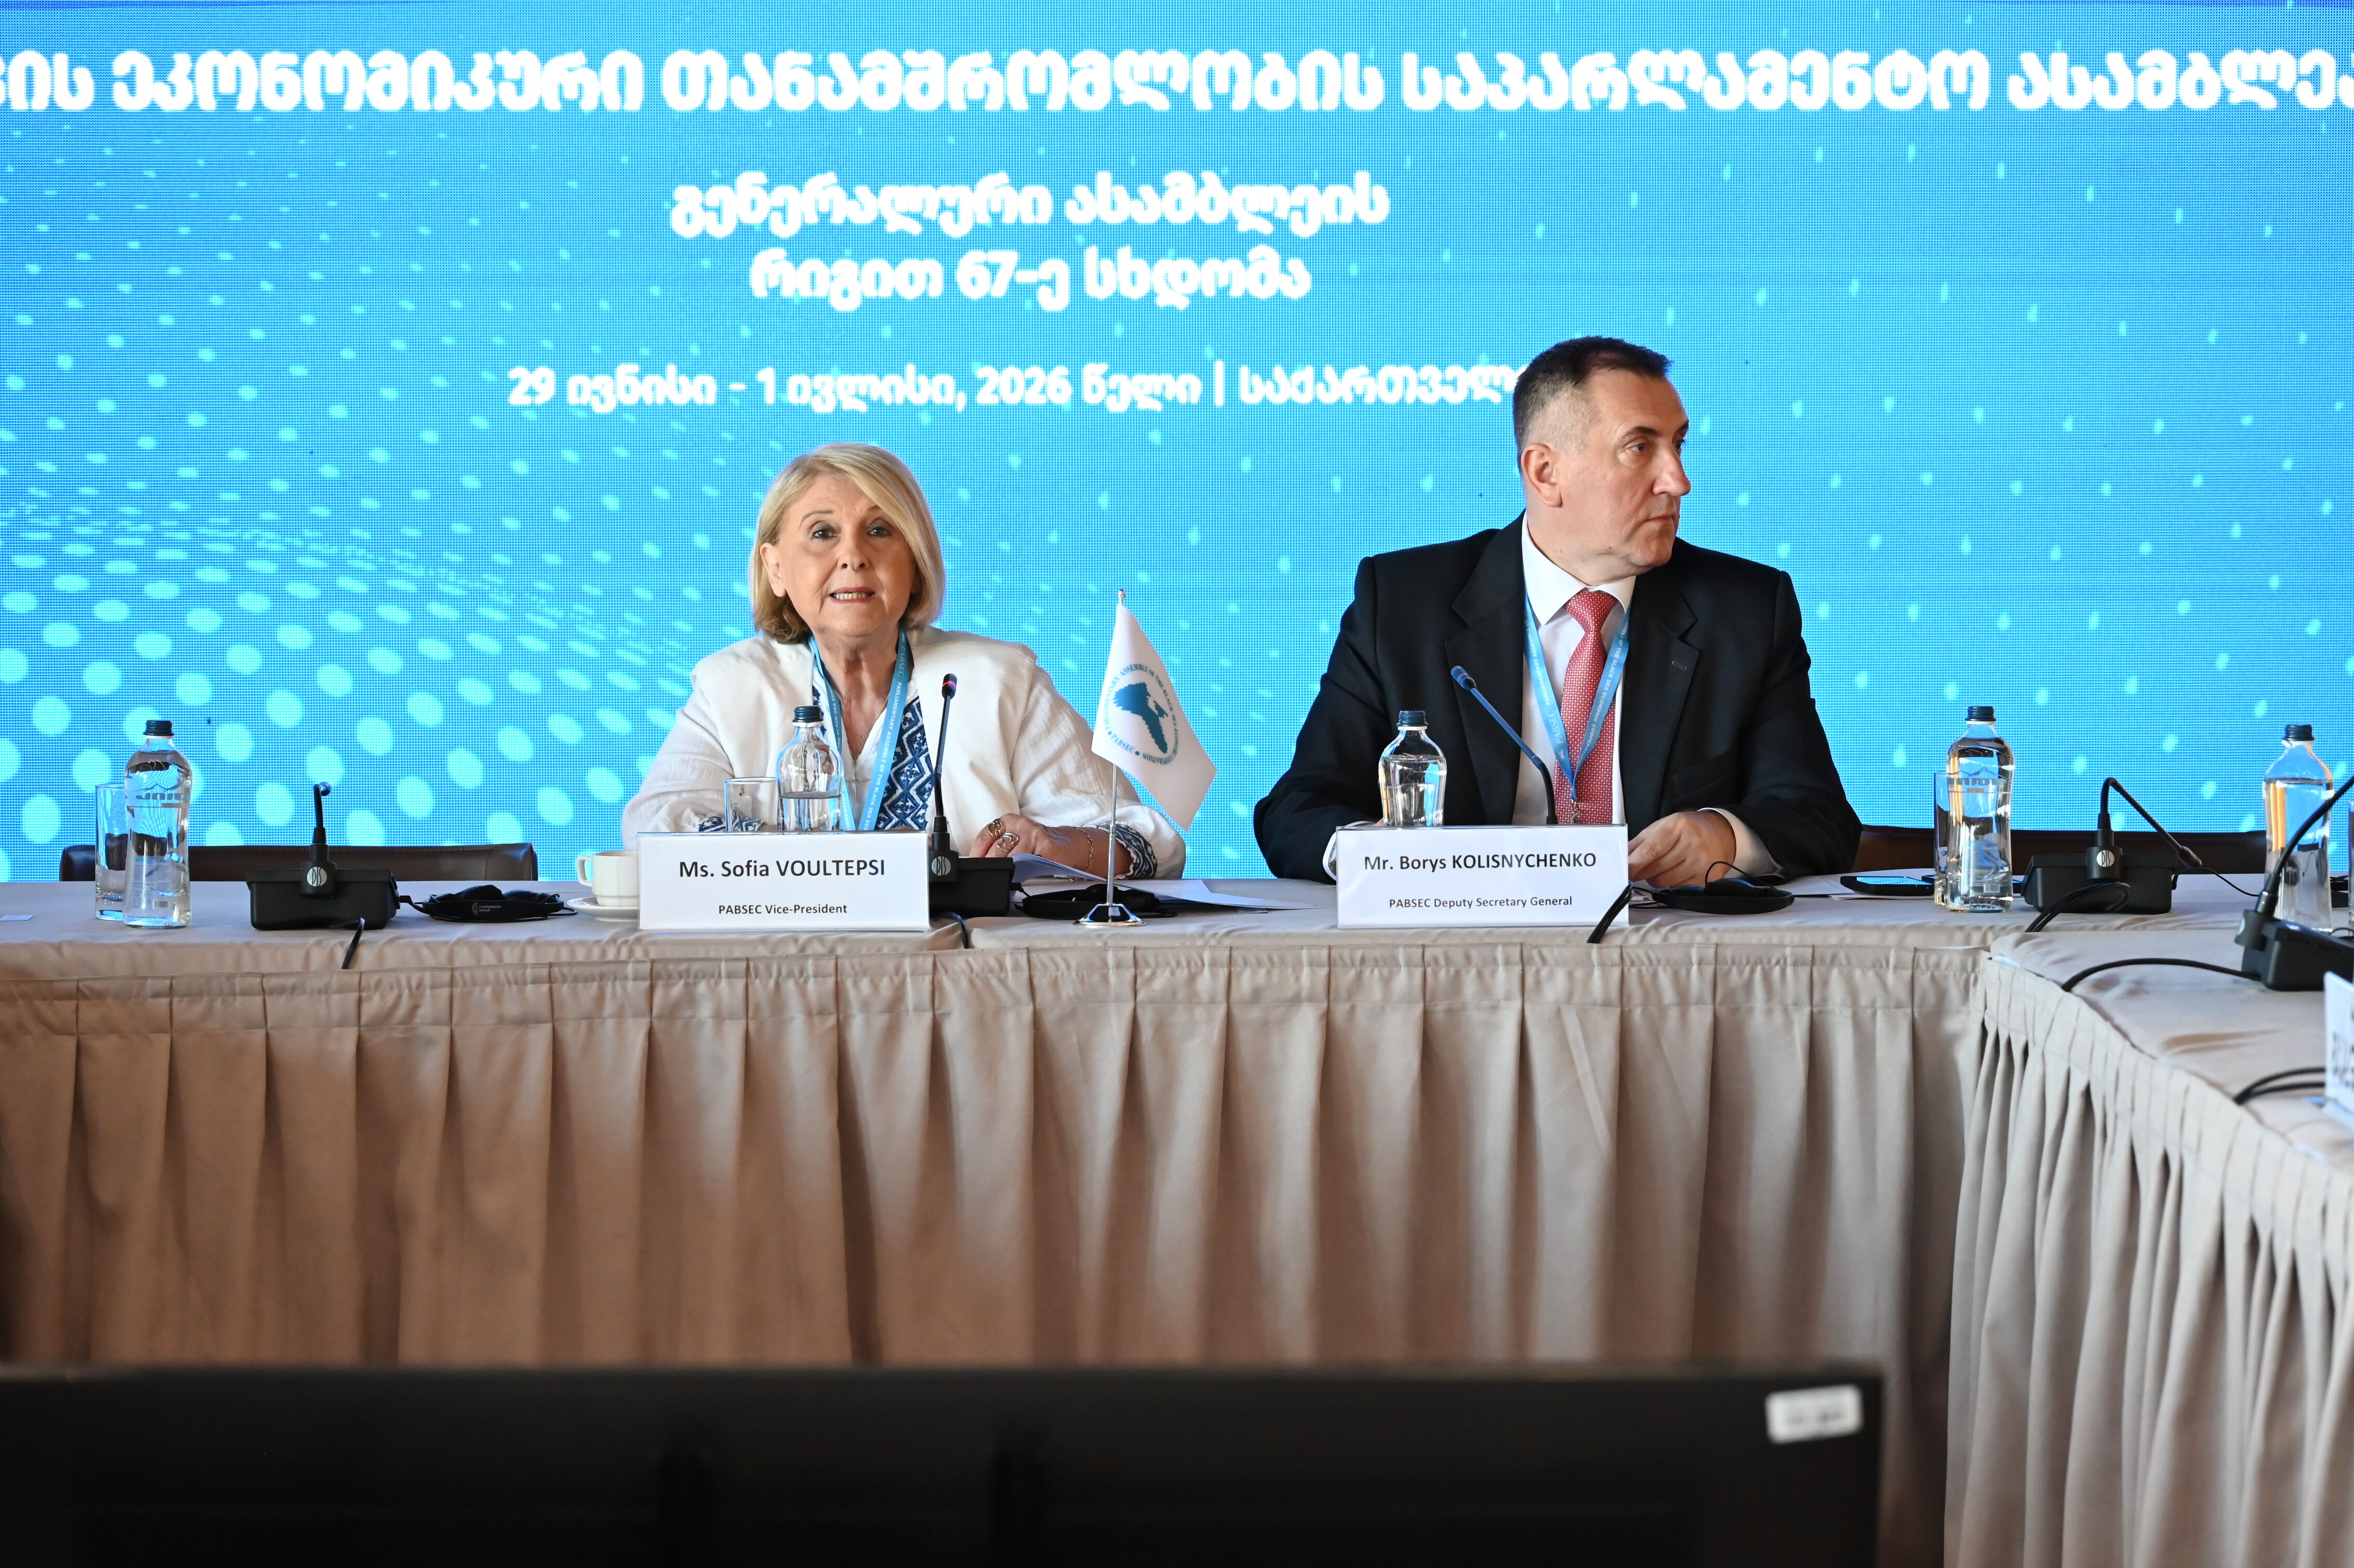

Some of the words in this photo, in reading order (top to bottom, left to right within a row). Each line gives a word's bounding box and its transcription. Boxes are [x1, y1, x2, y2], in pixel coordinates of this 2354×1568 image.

[0, 50, 94, 110] ის
[114, 50, 643, 110] ეკონომიკური
[663, 50, 1383, 110] თანამშრომლობის
[1403, 50, 1989, 110] საპარლამენტო
[672, 172, 1052, 238] გენერალური
[1066, 172, 1389, 237] ასამბლეის
[751, 249, 943, 311] რიგით
[957, 251, 1069, 311] 67-ე
[1086, 245, 1311, 310] სხდომა
[509, 367, 555, 404] 29
[568, 364, 716, 413] ივნისი
[757, 368, 774, 404] 1
[788, 364, 965, 412] ივლისი,
[977, 367, 1072, 404] 2026
[1083, 364, 1201, 412] წელი
[1240, 366, 1526, 404] საქართველ
[1608, 659, 1617, 678] BLACK
[888, 682, 902, 730] PARLIAMENTARY
[1593, 692, 1607, 723] ECONOMIC
[1547, 710, 1563, 744] PABSEC
[881, 731, 892, 763] ASSEMBLY
[1110, 734, 1134, 753] PABSEC
[880, 764, 885, 773] OF
[871, 787, 879, 806] BLACK
[679, 861, 715, 878] Ms.
[721, 860, 769, 878] Sofia
[776, 859, 885, 877] VOULTEPSI
[1364, 856, 1394, 870] Mr.
[1400, 855, 1447, 873] Borys
[1453, 853, 1597, 869] KOLISNYCHENKO
[718, 905, 762, 915] PABSEC
[765, 904, 848, 914] Vice-President
[1389, 898, 1431, 908] PABSEC
[1434, 898, 1473, 910] Deputy
[1476, 897, 1527, 908] Secretary
[1530, 896, 1573, 907] General
